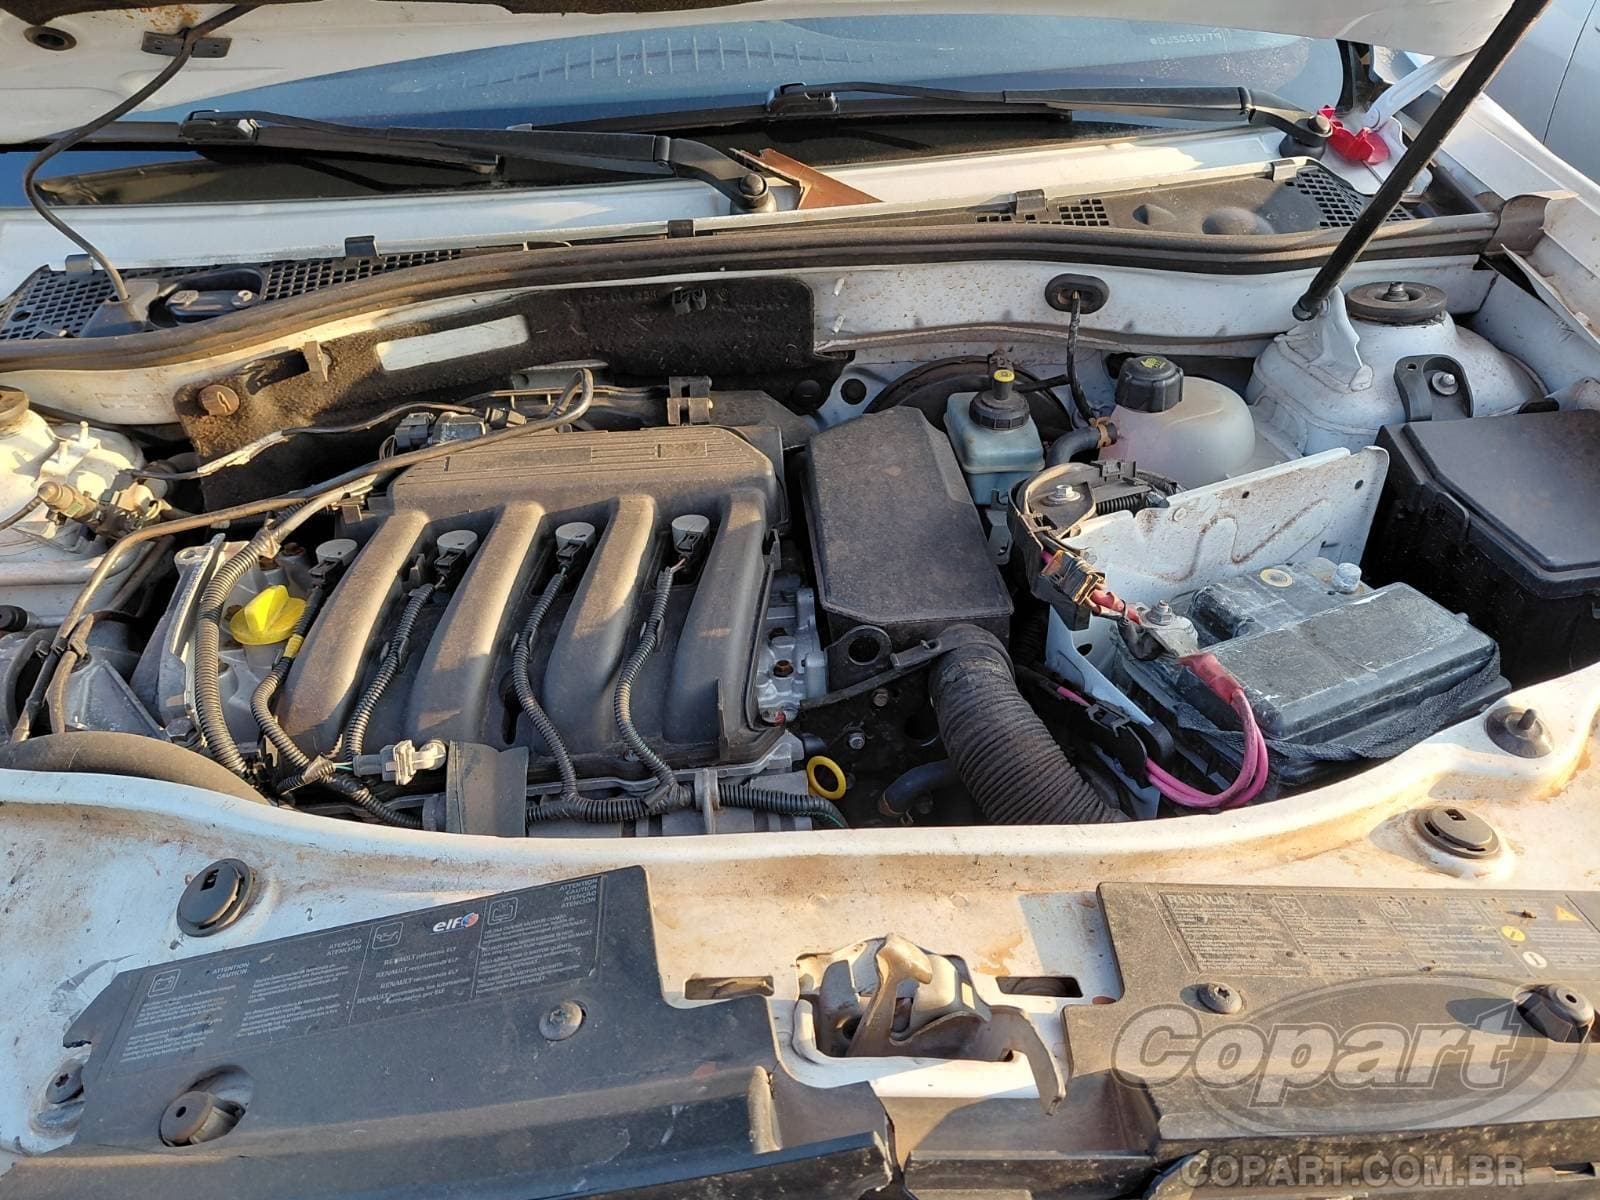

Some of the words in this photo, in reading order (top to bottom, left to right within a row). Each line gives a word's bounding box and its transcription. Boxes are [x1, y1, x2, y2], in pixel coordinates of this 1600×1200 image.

[560, 878, 597, 891] ATTENTION
[566, 884, 596, 895] CAUTION
[1166, 894, 1239, 906] RENAULT
[212, 962, 249, 974] ATTENTION
[217, 969, 247, 979] CAUTION
